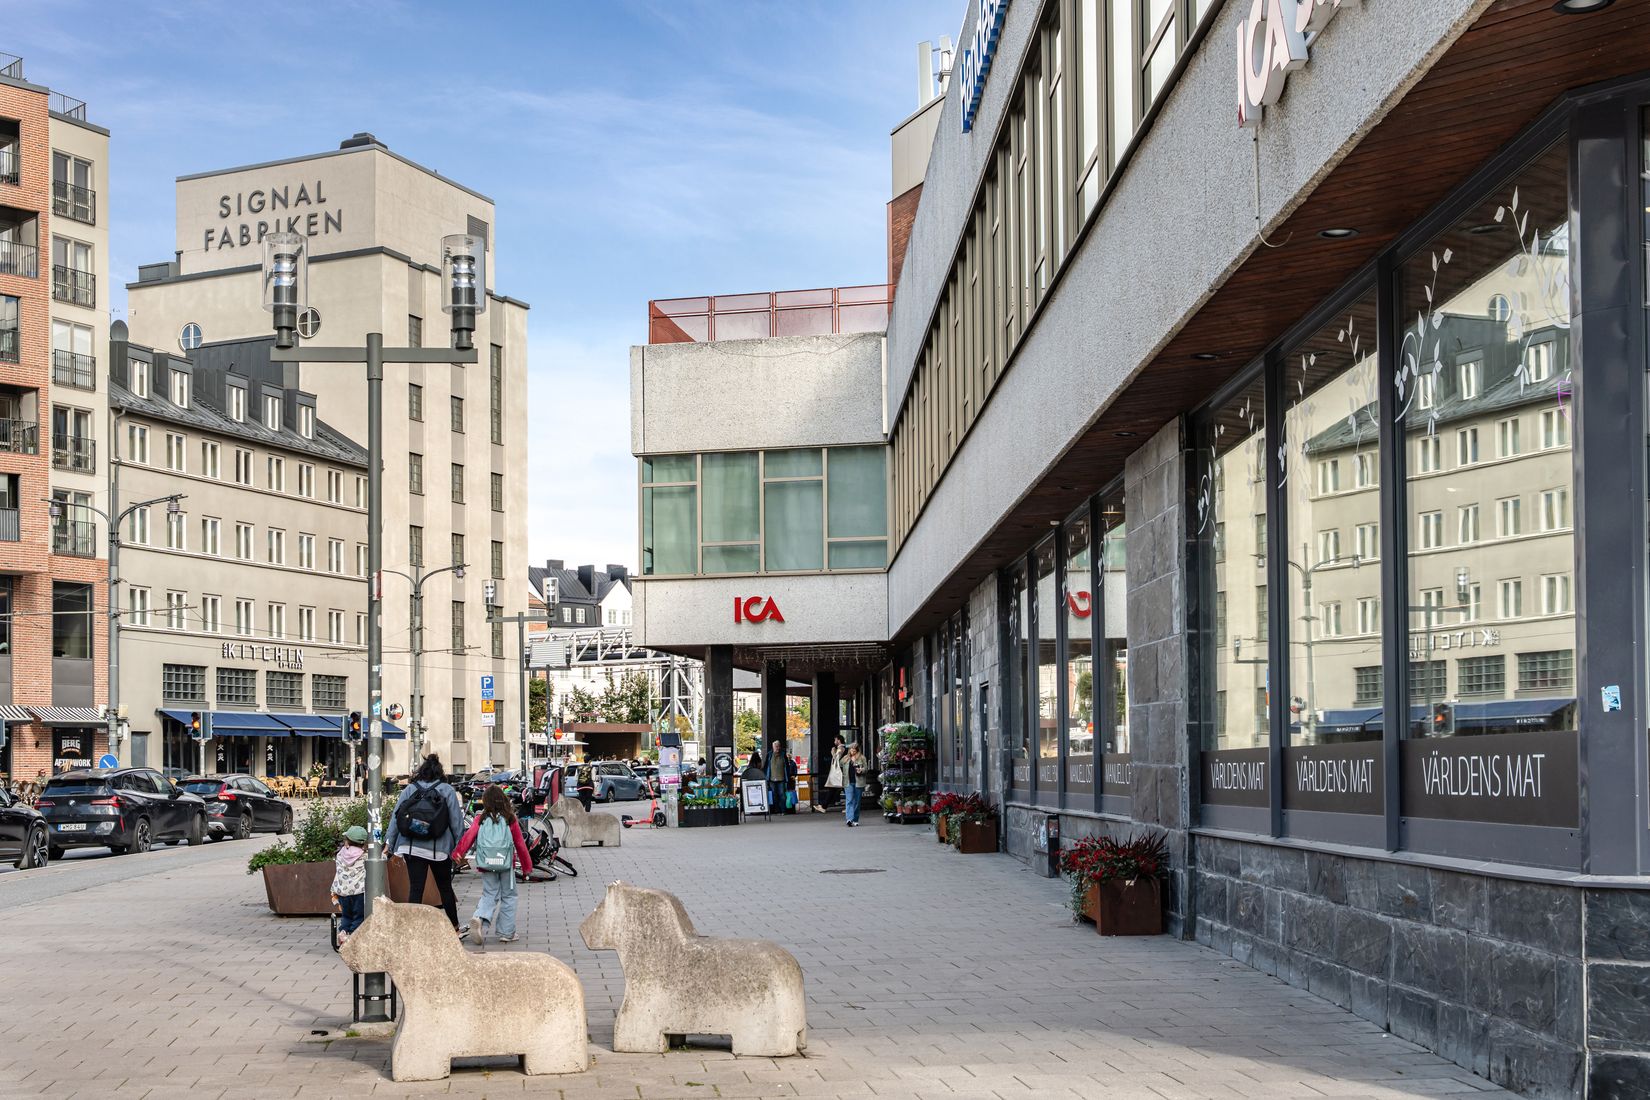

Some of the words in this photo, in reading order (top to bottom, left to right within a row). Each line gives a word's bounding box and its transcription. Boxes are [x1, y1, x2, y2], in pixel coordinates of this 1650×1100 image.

[960, 0, 999, 132] Handels
[219, 180, 327, 218] SIGNAL
[204, 208, 342, 251] FABRIKEN
[734, 595, 785, 624] ICA
[227, 642, 304, 664] KITCHIN
[483, 677, 491, 689] P
[61, 739, 81, 750] BERG
[73, 758, 92, 767] WORK
[1210, 758, 1247, 790] VÄRLDENS
[1248, 762, 1265, 790] MAT
[1296, 755, 1347, 793] VÄRLDENS
[1350, 759, 1375, 793] MAT
[1422, 750, 1502, 797] VÄRLDENS
[1506, 753, 1545, 798] MAT
